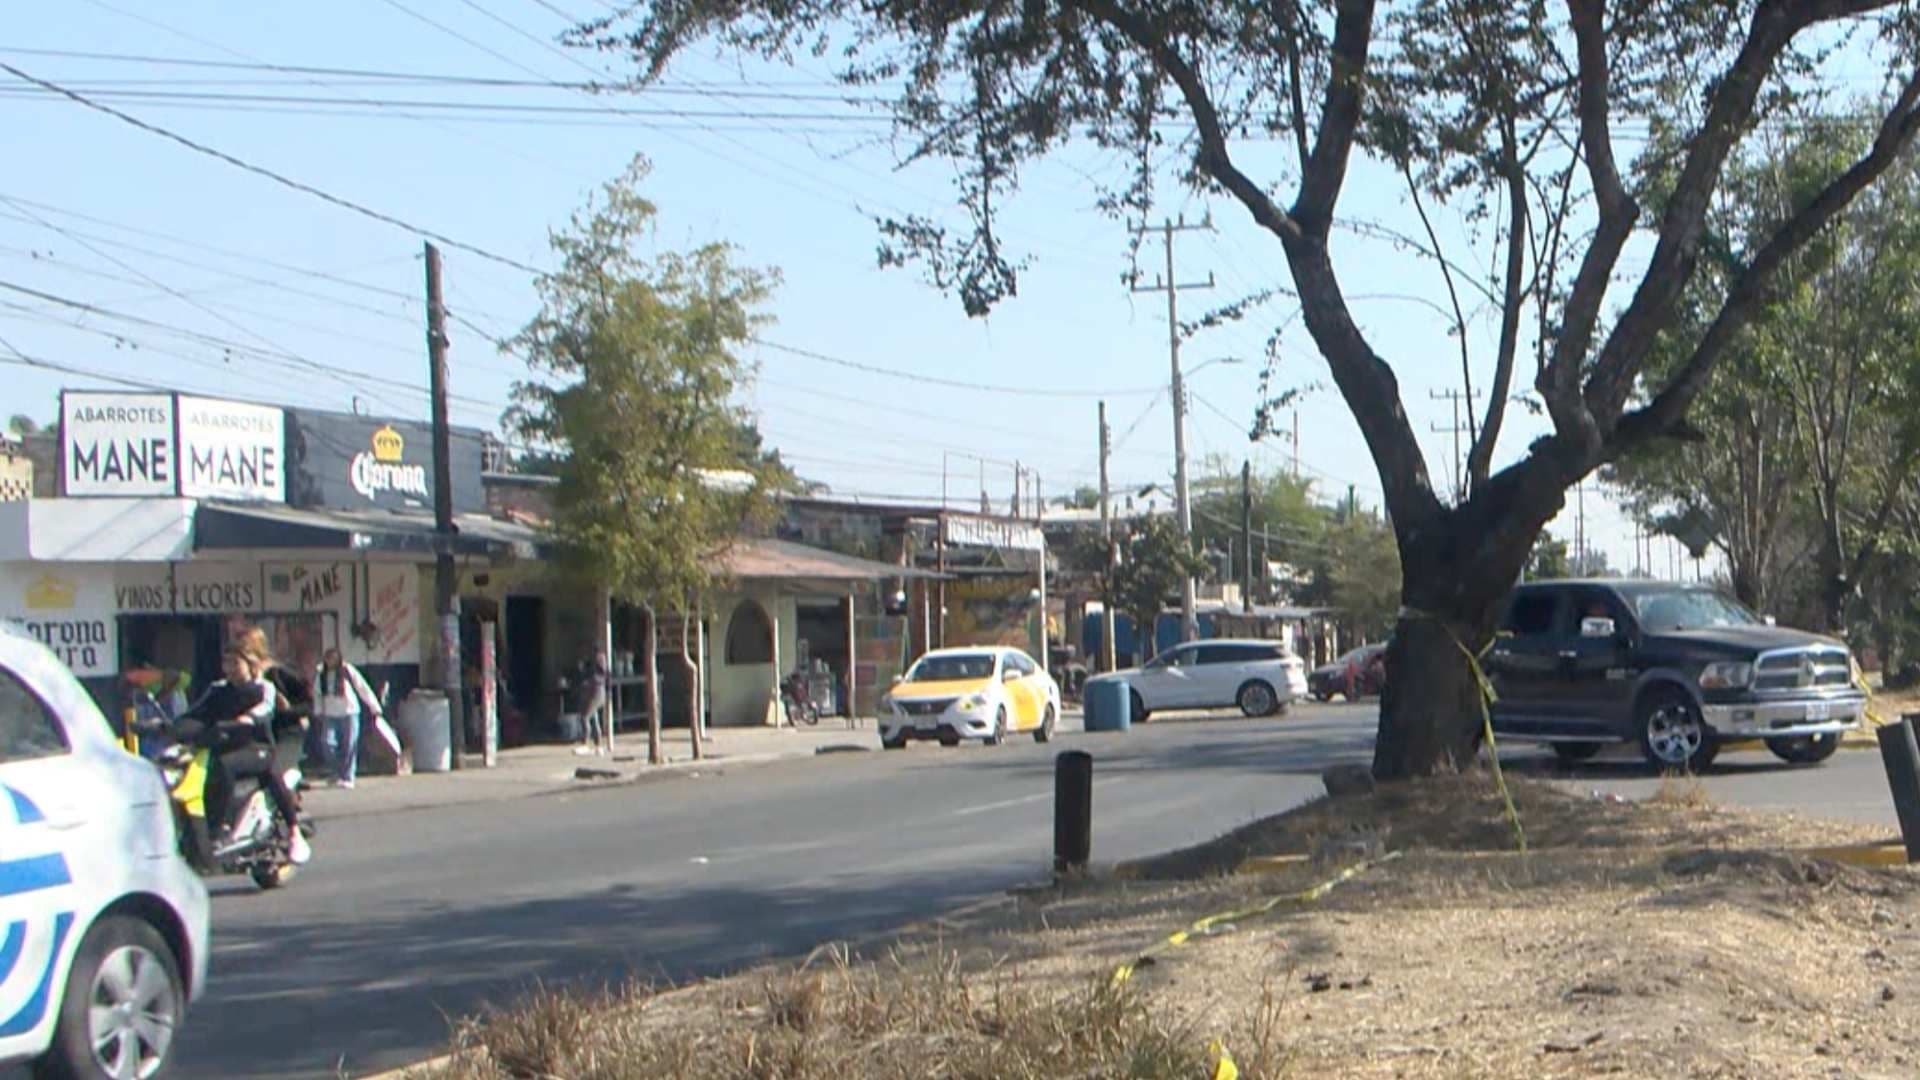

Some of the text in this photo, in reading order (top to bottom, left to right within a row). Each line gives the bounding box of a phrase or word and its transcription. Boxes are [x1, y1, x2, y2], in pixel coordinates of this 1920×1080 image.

[74, 407, 166, 423] ABARROTES
[190, 411, 274, 432] ABARROTES
[72, 438, 168, 482] MANE
[190, 443, 275, 487] MANE
[350, 450, 429, 501] Corona
[115, 584, 163, 609] VINOS
[183, 582, 253, 610] LICORES
